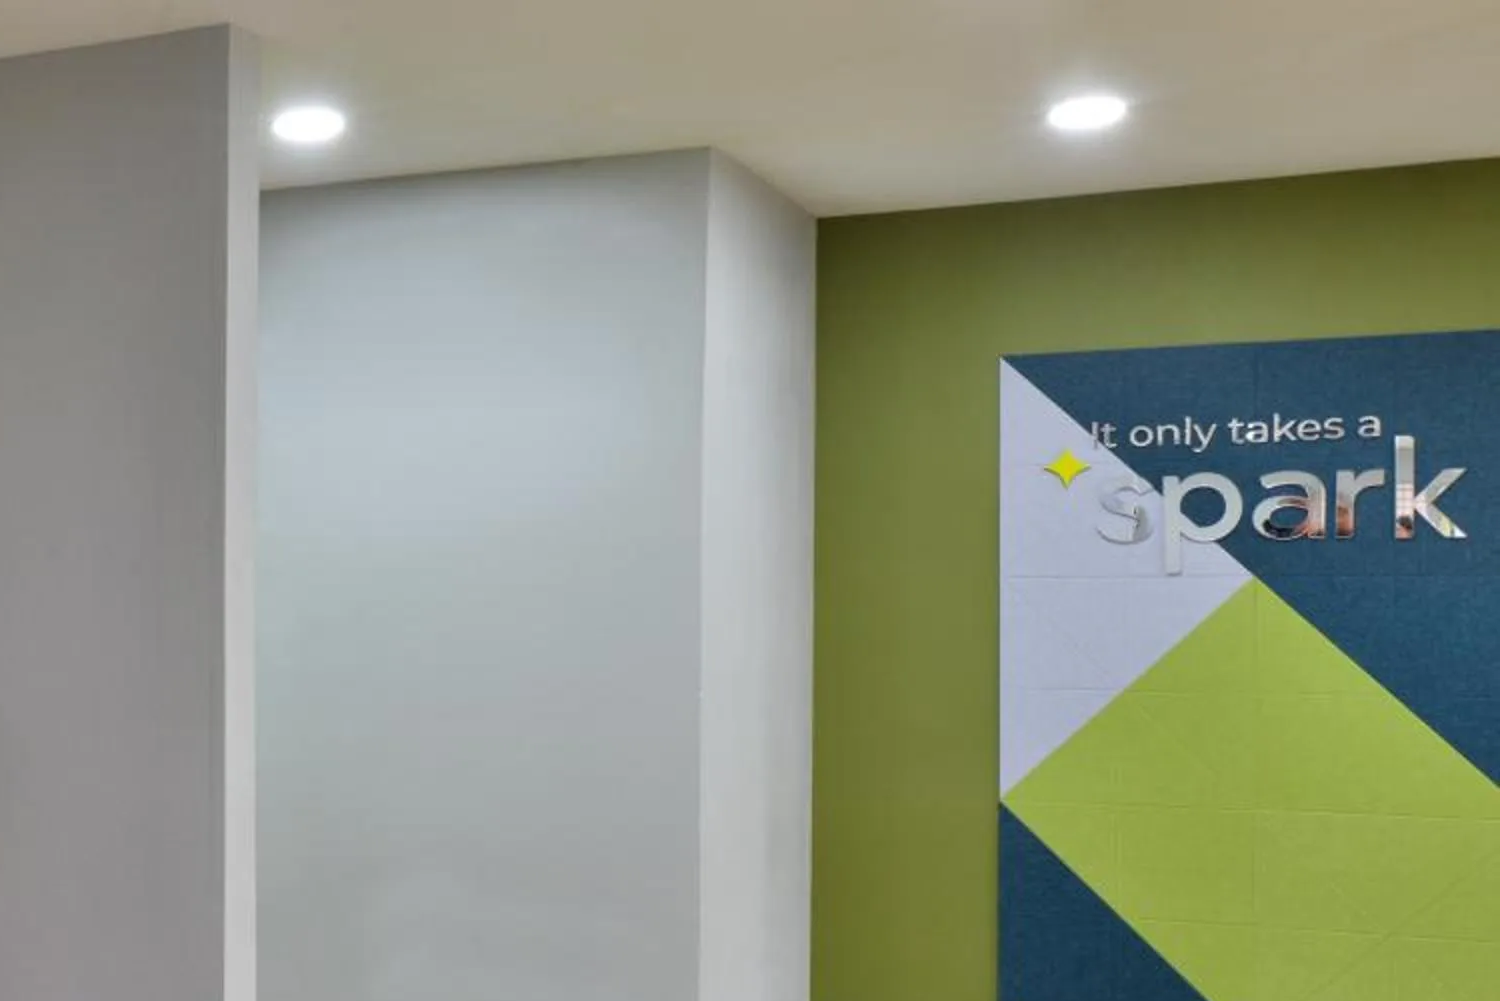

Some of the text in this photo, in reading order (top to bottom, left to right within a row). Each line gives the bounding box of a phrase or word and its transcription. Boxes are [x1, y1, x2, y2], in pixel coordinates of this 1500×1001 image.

[1128, 416, 1217, 453] only
[1227, 412, 1346, 445] takes
[1357, 415, 1382, 438] a
[1097, 435, 1468, 577] spark
